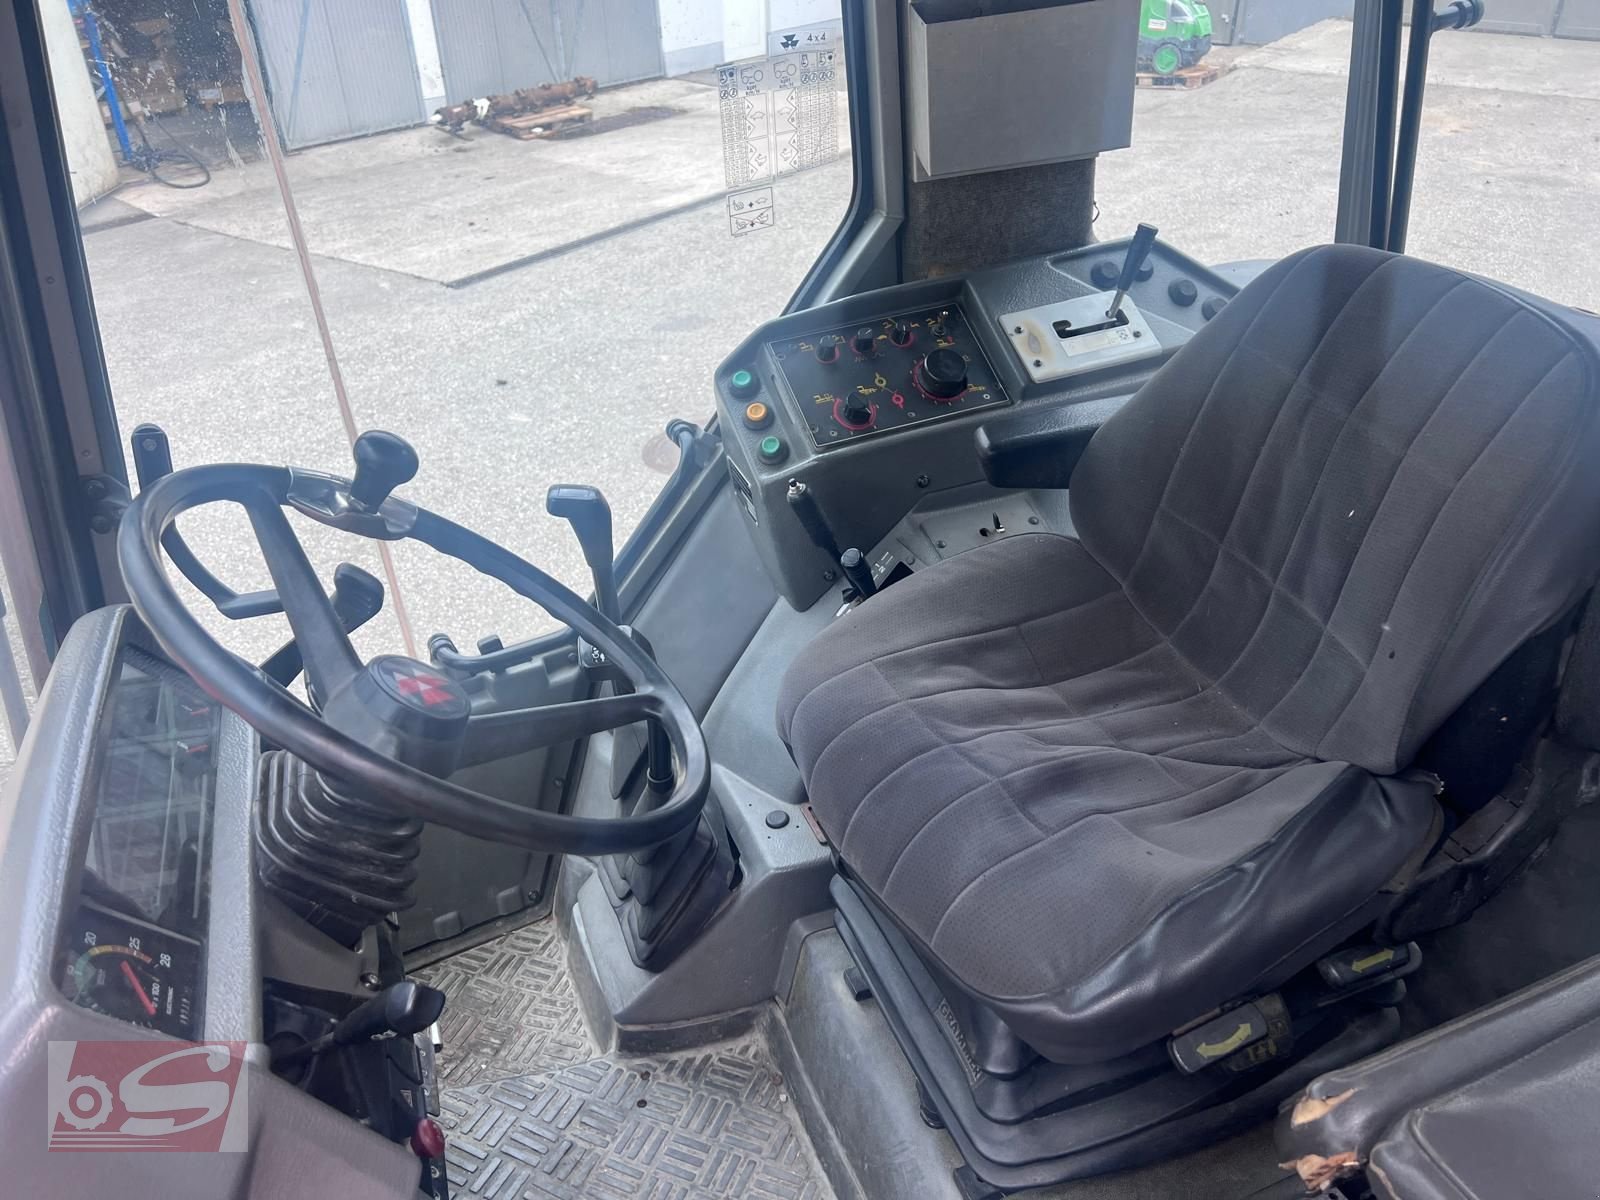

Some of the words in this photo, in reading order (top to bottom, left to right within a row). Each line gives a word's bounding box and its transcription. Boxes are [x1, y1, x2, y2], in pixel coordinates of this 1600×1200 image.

[84, 931, 97, 946] 20
[129, 936, 141, 950] 25
[160, 953, 172, 968] 28
